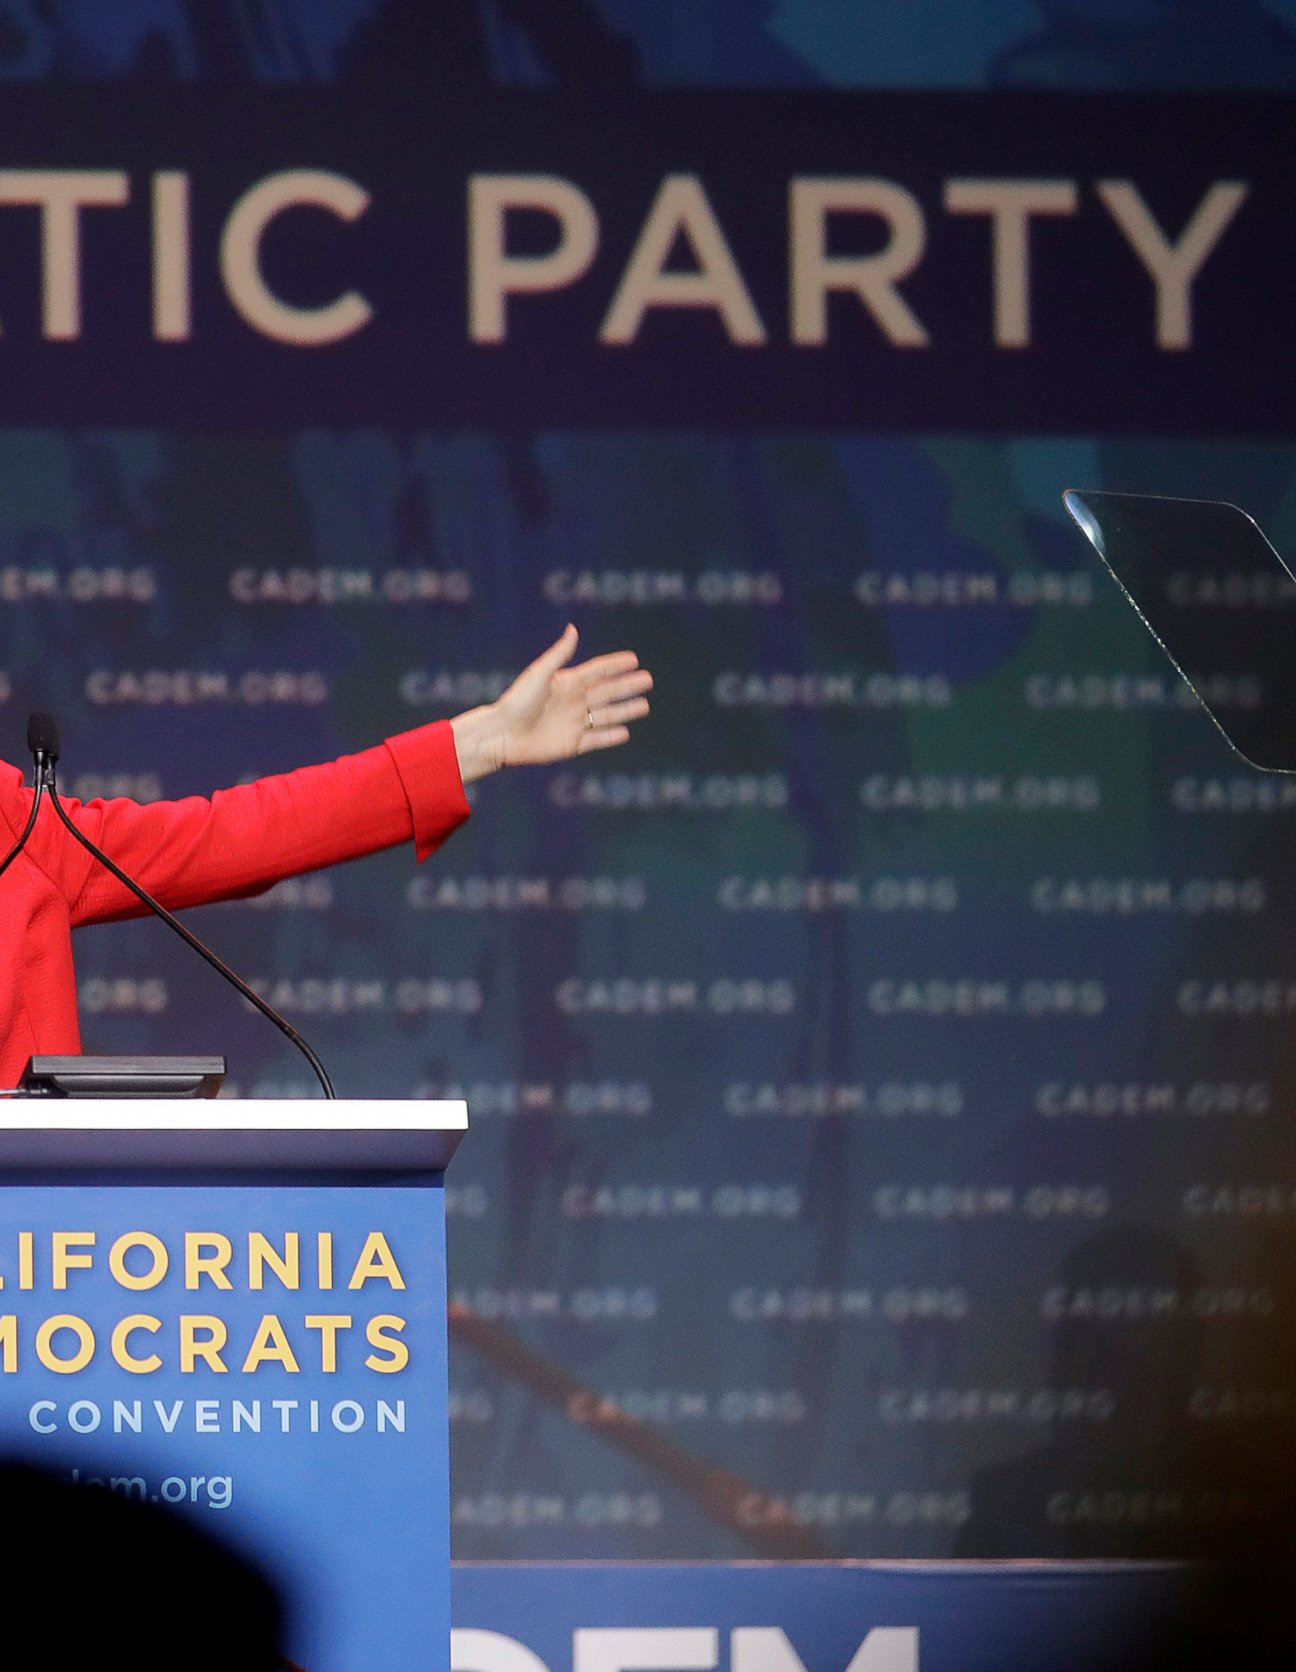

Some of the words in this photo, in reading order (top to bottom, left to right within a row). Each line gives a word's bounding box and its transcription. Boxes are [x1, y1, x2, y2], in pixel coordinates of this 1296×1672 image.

[468, 173, 1249, 350] PARTY
[229, 567, 472, 603] CADEM.ORG
[543, 568, 784, 604] CADEM.ORG
[854, 570, 1095, 606] CADEM.ORG
[85, 668, 328, 706] CADEM.ORG
[713, 672, 954, 708] CADEM.ORG
[1024, 674, 1262, 710] CADEM.ORG
[549, 774, 790, 810] CADEM.ORG
[860, 775, 1100, 811] CADEM.ORG
[407, 876, 648, 911] CADEM.ORG
[718, 877, 959, 912] CADEM.ORG
[1030, 878, 1266, 914] CADEM.ORG
[245, 977, 483, 1013] CADEM.ORG
[555, 978, 797, 1014] CADEM.ORG
[868, 979, 1106, 1016] CADEM.ORG
[723, 1080, 964, 1117] CADEM.ORG
[1036, 1081, 1271, 1117] CADEM.ORG
[562, 1183, 802, 1219] CADEM.ORG
[873, 1184, 1111, 1219] CADEM.ORG
[728, 1287, 969, 1322] CADEM.ORG
[1040, 1286, 1275, 1321] CADEM.ORG
[29, 1400, 407, 1434] CONVENTION
[568, 1390, 807, 1426] CADEM.ORG
[878, 1389, 1117, 1424] CADEM.ORG
[736, 1493, 972, 1527] CADEM.ORG
